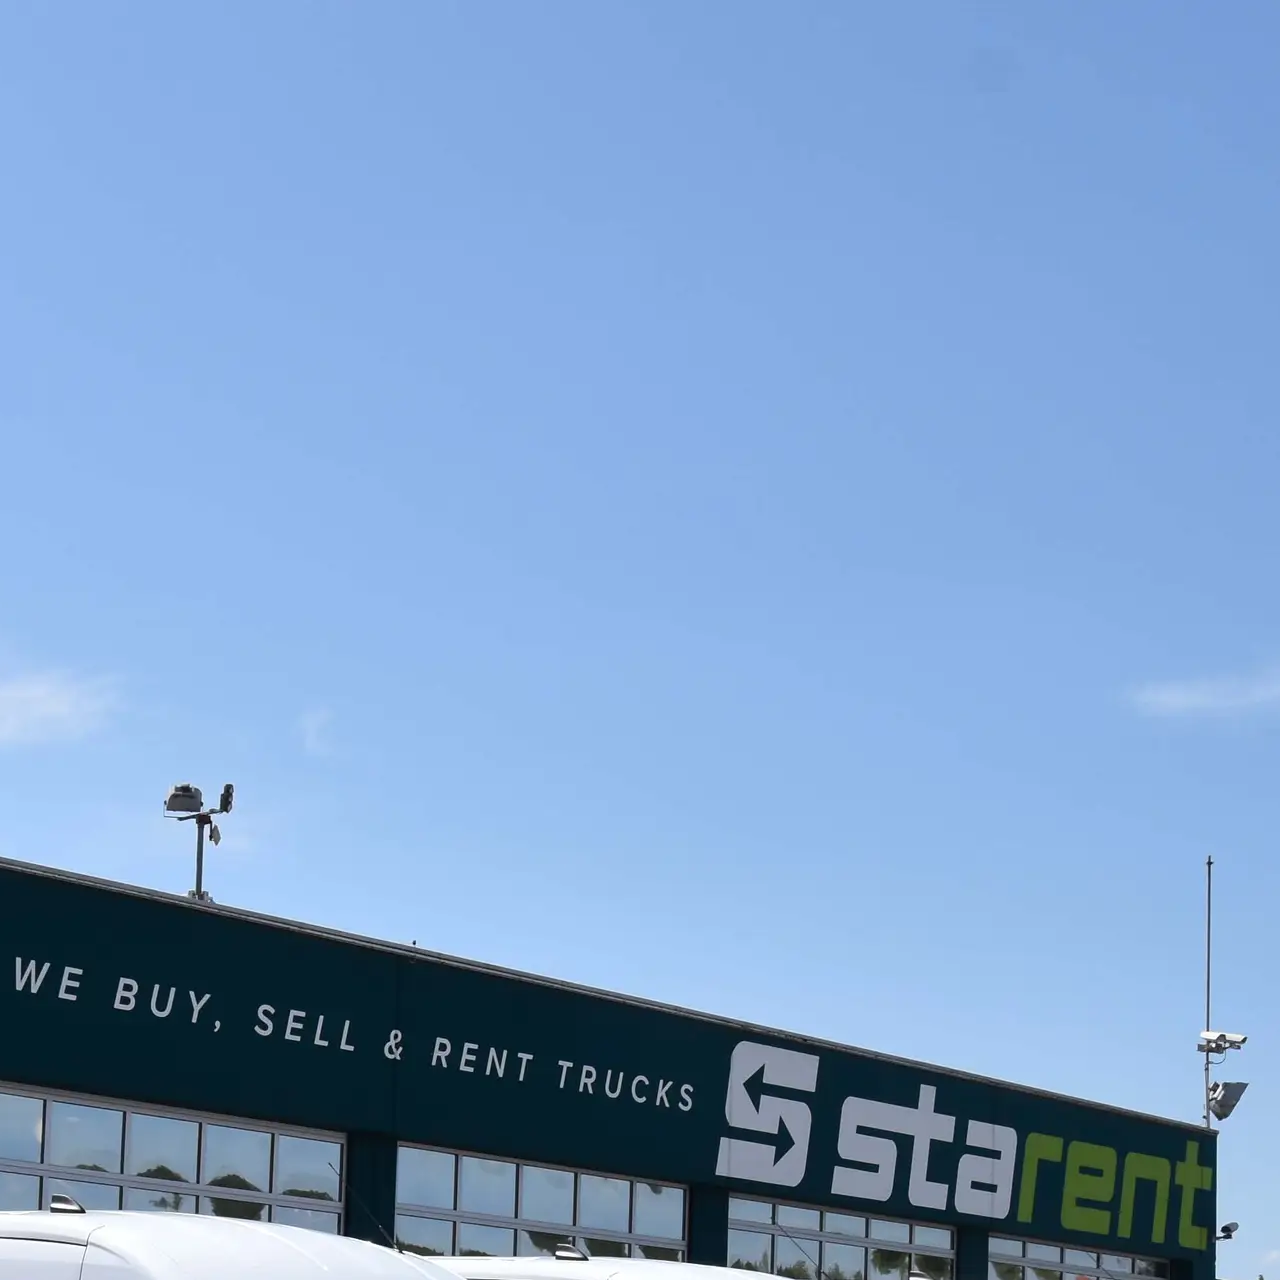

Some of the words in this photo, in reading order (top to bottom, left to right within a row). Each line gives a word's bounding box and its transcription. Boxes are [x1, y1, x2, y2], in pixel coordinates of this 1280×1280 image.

[15, 956, 83, 1001] WE
[114, 976, 221, 1032] BUY,
[254, 1004, 355, 1051] SELL
[384, 1029, 403, 1060] &
[431, 1036, 534, 1082] RENT
[558, 1060, 694, 1112] TRUCKS
[830, 1083, 1213, 1251] starent
